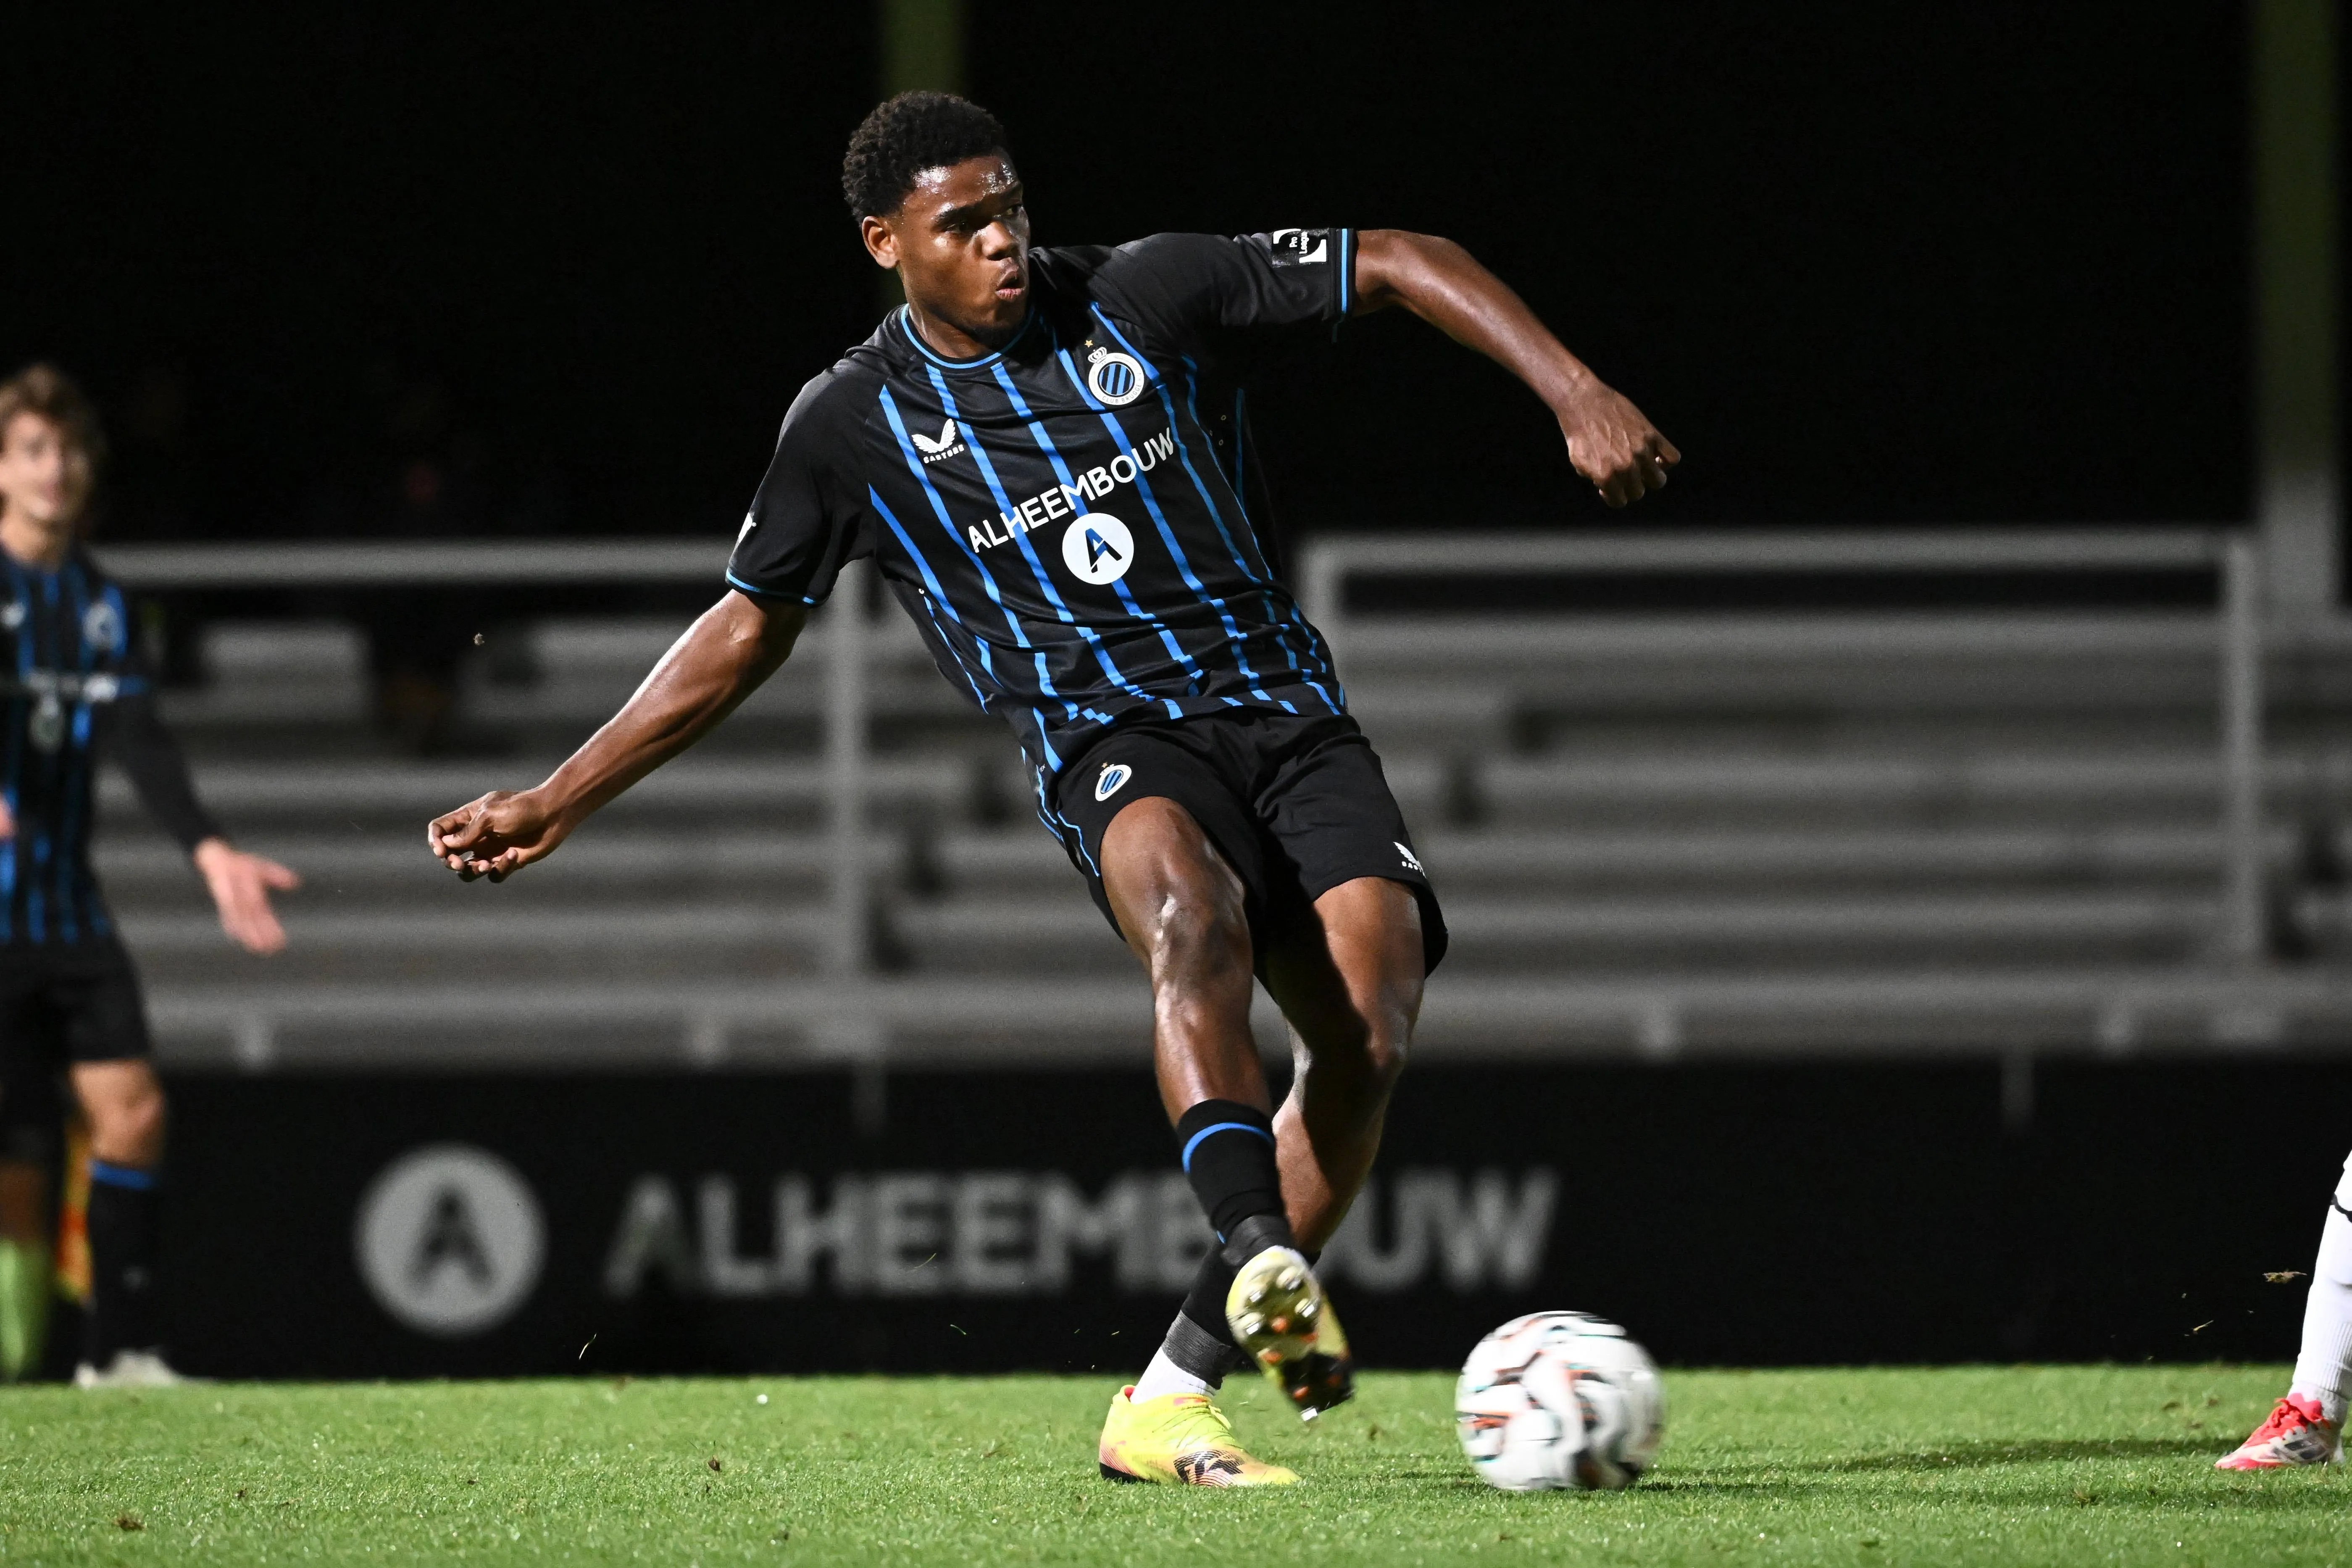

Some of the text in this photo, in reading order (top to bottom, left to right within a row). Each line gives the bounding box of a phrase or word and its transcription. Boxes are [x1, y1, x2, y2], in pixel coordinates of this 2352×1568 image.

[1289, 237, 1298, 247] Pro
[1121, 384, 1142, 403] BRUGGE
[968, 427, 1174, 553] ALHEEMBOUW
[1085, 528, 1122, 573] A
[405, 1170, 1557, 1297] A ALHEEMBUW
